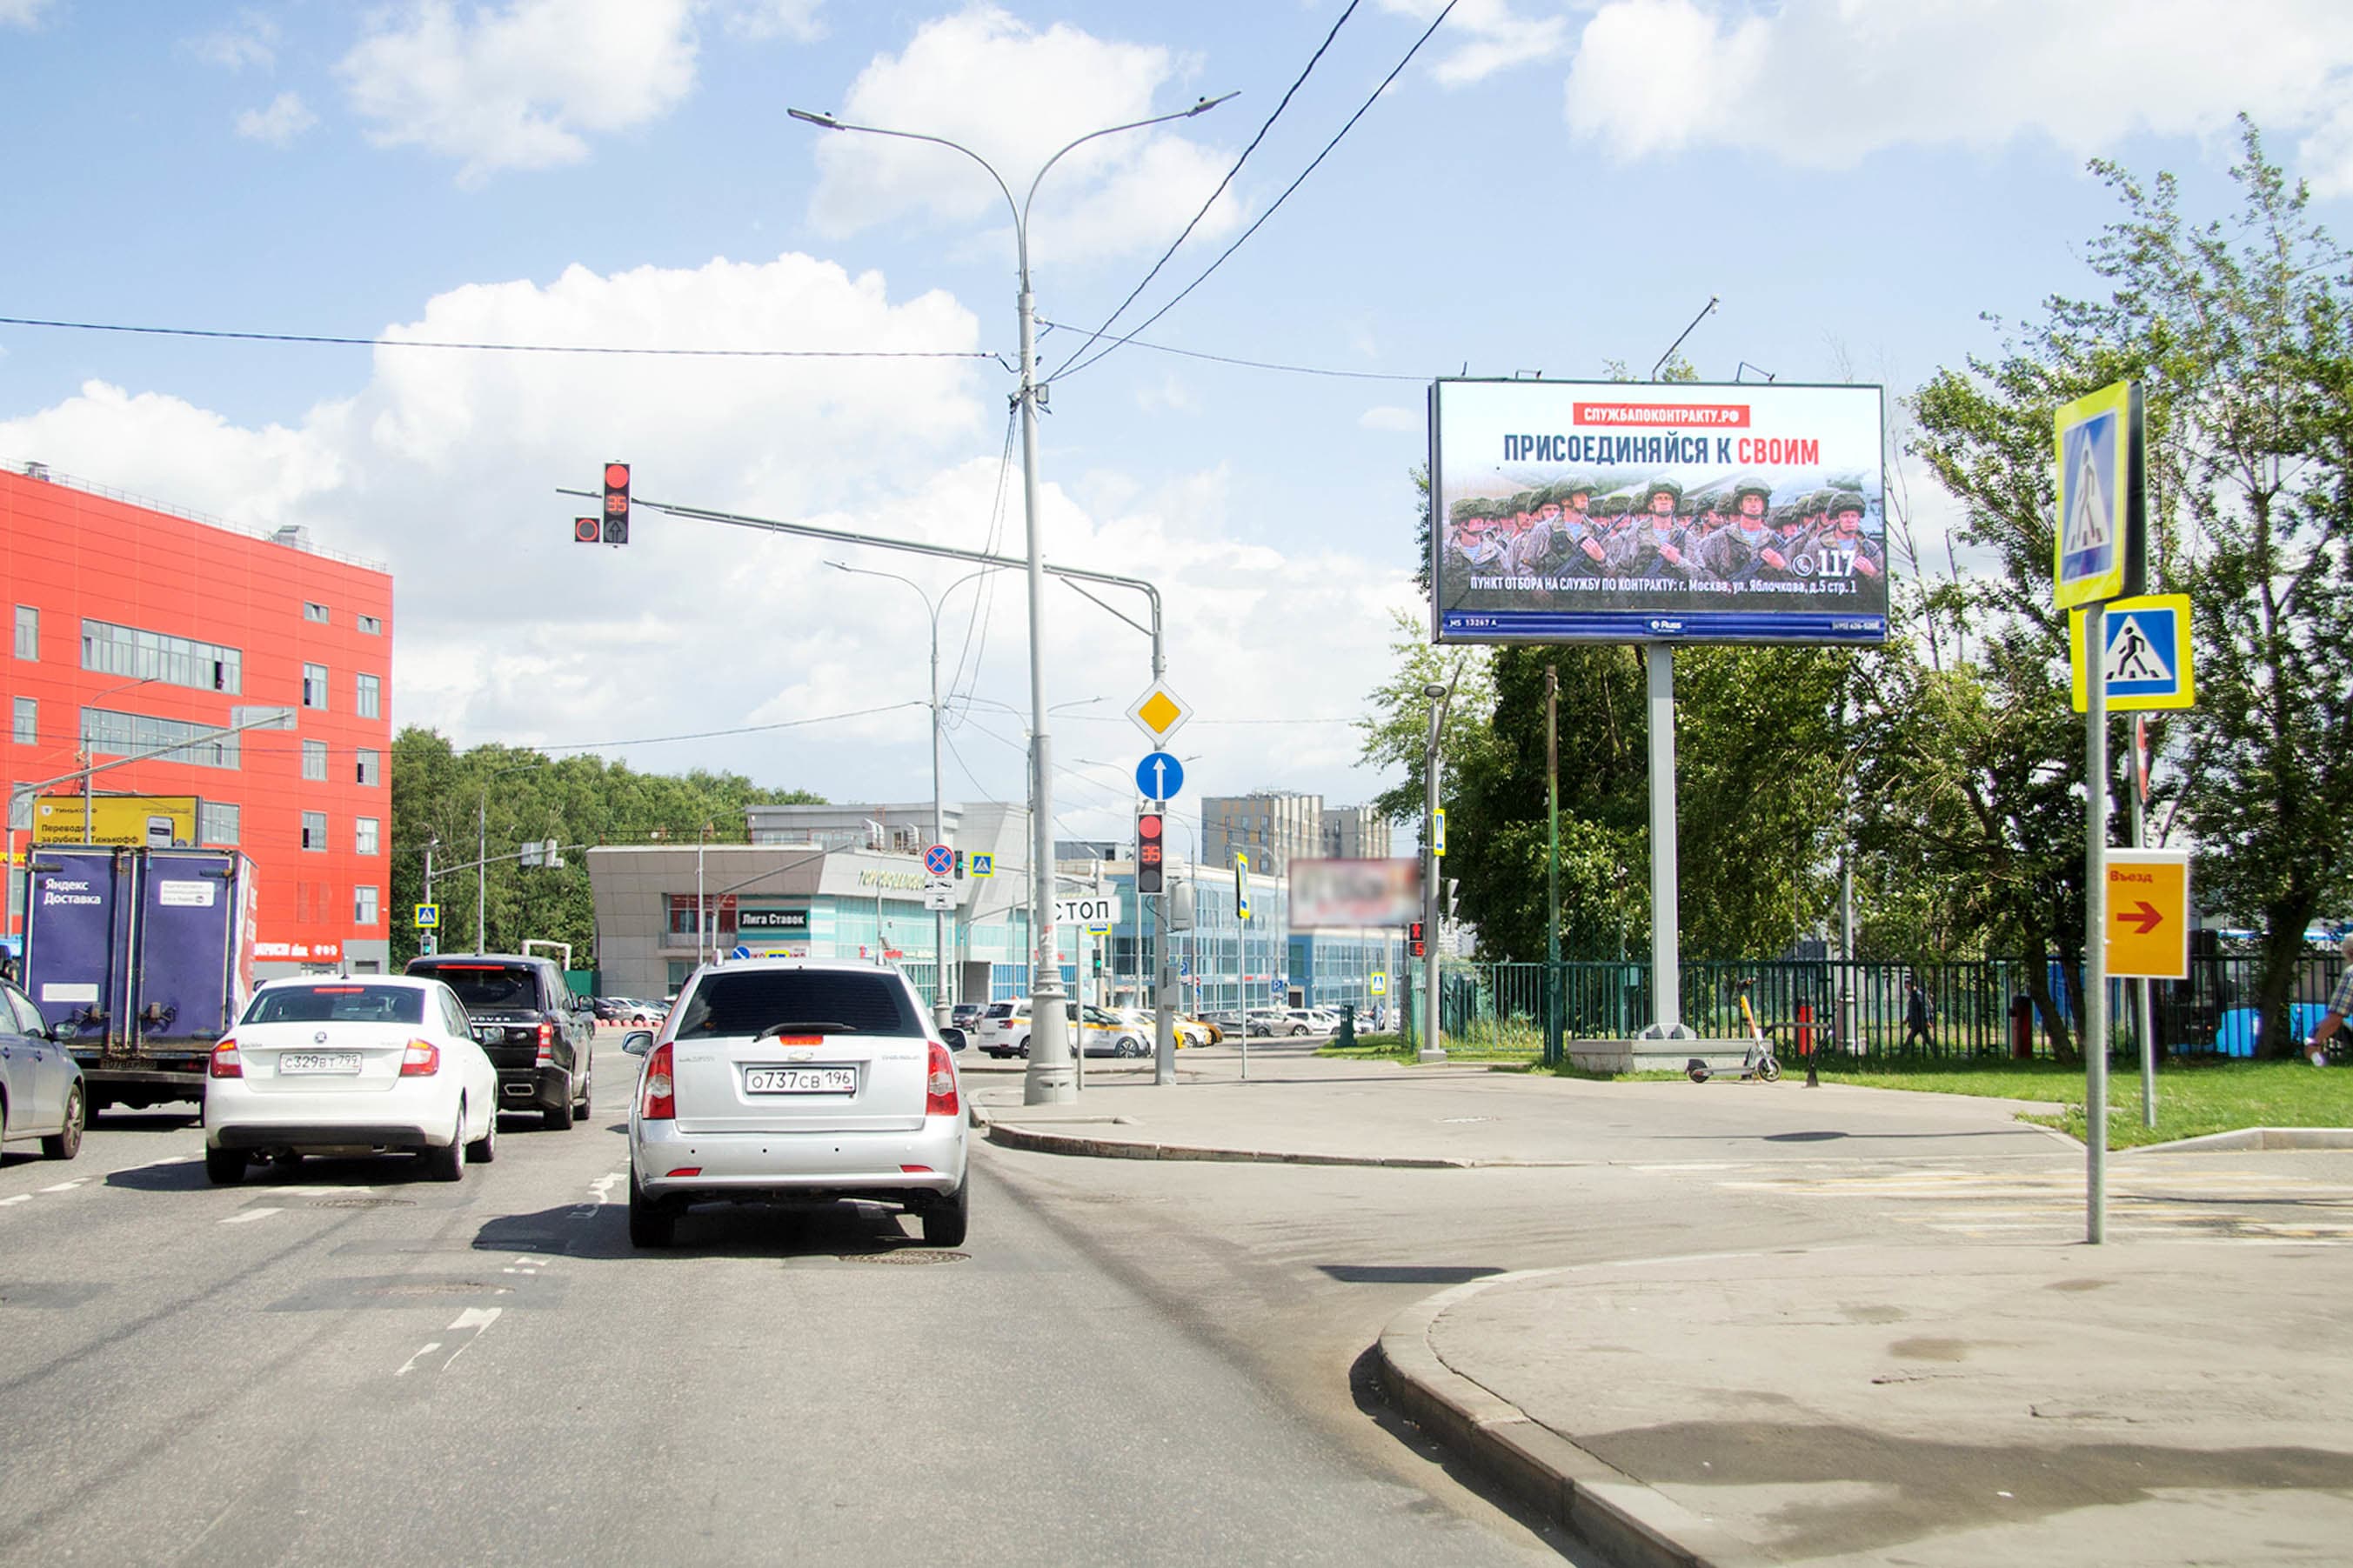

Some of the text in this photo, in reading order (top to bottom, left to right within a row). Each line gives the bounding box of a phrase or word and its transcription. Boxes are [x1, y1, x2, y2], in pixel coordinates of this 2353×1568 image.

[1583, 406, 1740, 424] СЛУЖБАПОКОНТРАКТУ.РФ
[1504, 430, 1820, 465] ПРИСОЕДИНЯЙСЯ К СВОИМ
[606, 495, 627, 512] 35
[1817, 549, 1856, 577] 117
[1470, 576, 1503, 591] ПУНКТ
[1505, 576, 1543, 591] ОТБОРА
[1545, 577, 1559, 591] НА
[1560, 577, 1601, 591] СЛУЖБУ
[1601, 577, 1616, 591] ПО
[1618, 577, 1677, 592] КОНТРАКТУ:
[41, 824, 97, 833] Переводие
[2109, 870, 2154, 884] Въезд
[45, 878, 90, 891] Яндекс
[43, 891, 102, 905] Доставка
[742, 912, 805, 925] Лига Ставок
[825, 1071, 852, 1085] 196
